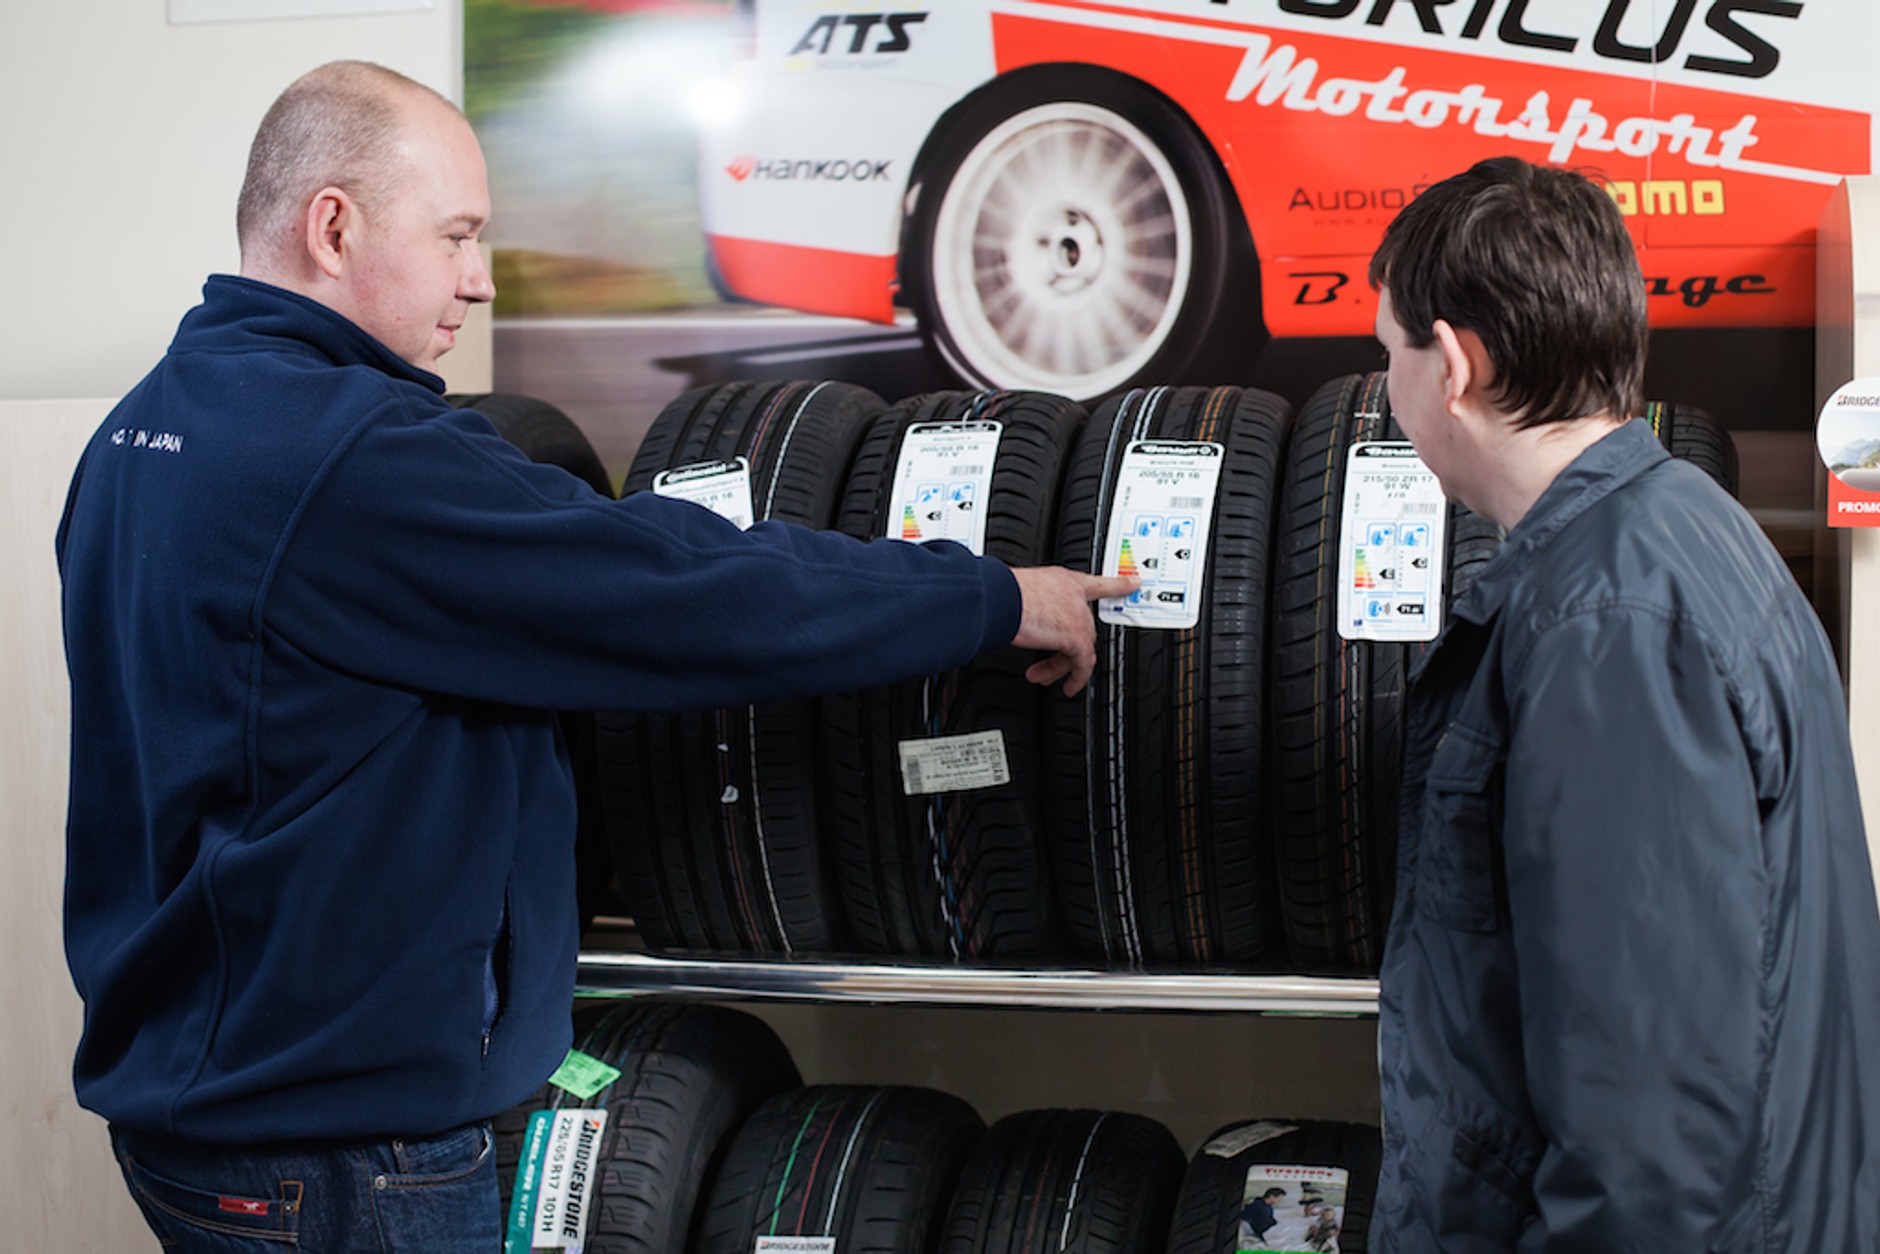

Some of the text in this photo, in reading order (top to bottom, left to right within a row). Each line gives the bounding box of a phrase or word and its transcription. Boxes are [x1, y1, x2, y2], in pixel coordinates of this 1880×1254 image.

[787, 12, 930, 55] ATS
[1225, 34, 1760, 167] Motorsport
[148, 432, 184, 453] JAPAN
[562, 1118, 601, 1240] BRIDGESTONE
[541, 1196, 557, 1232] 101H
